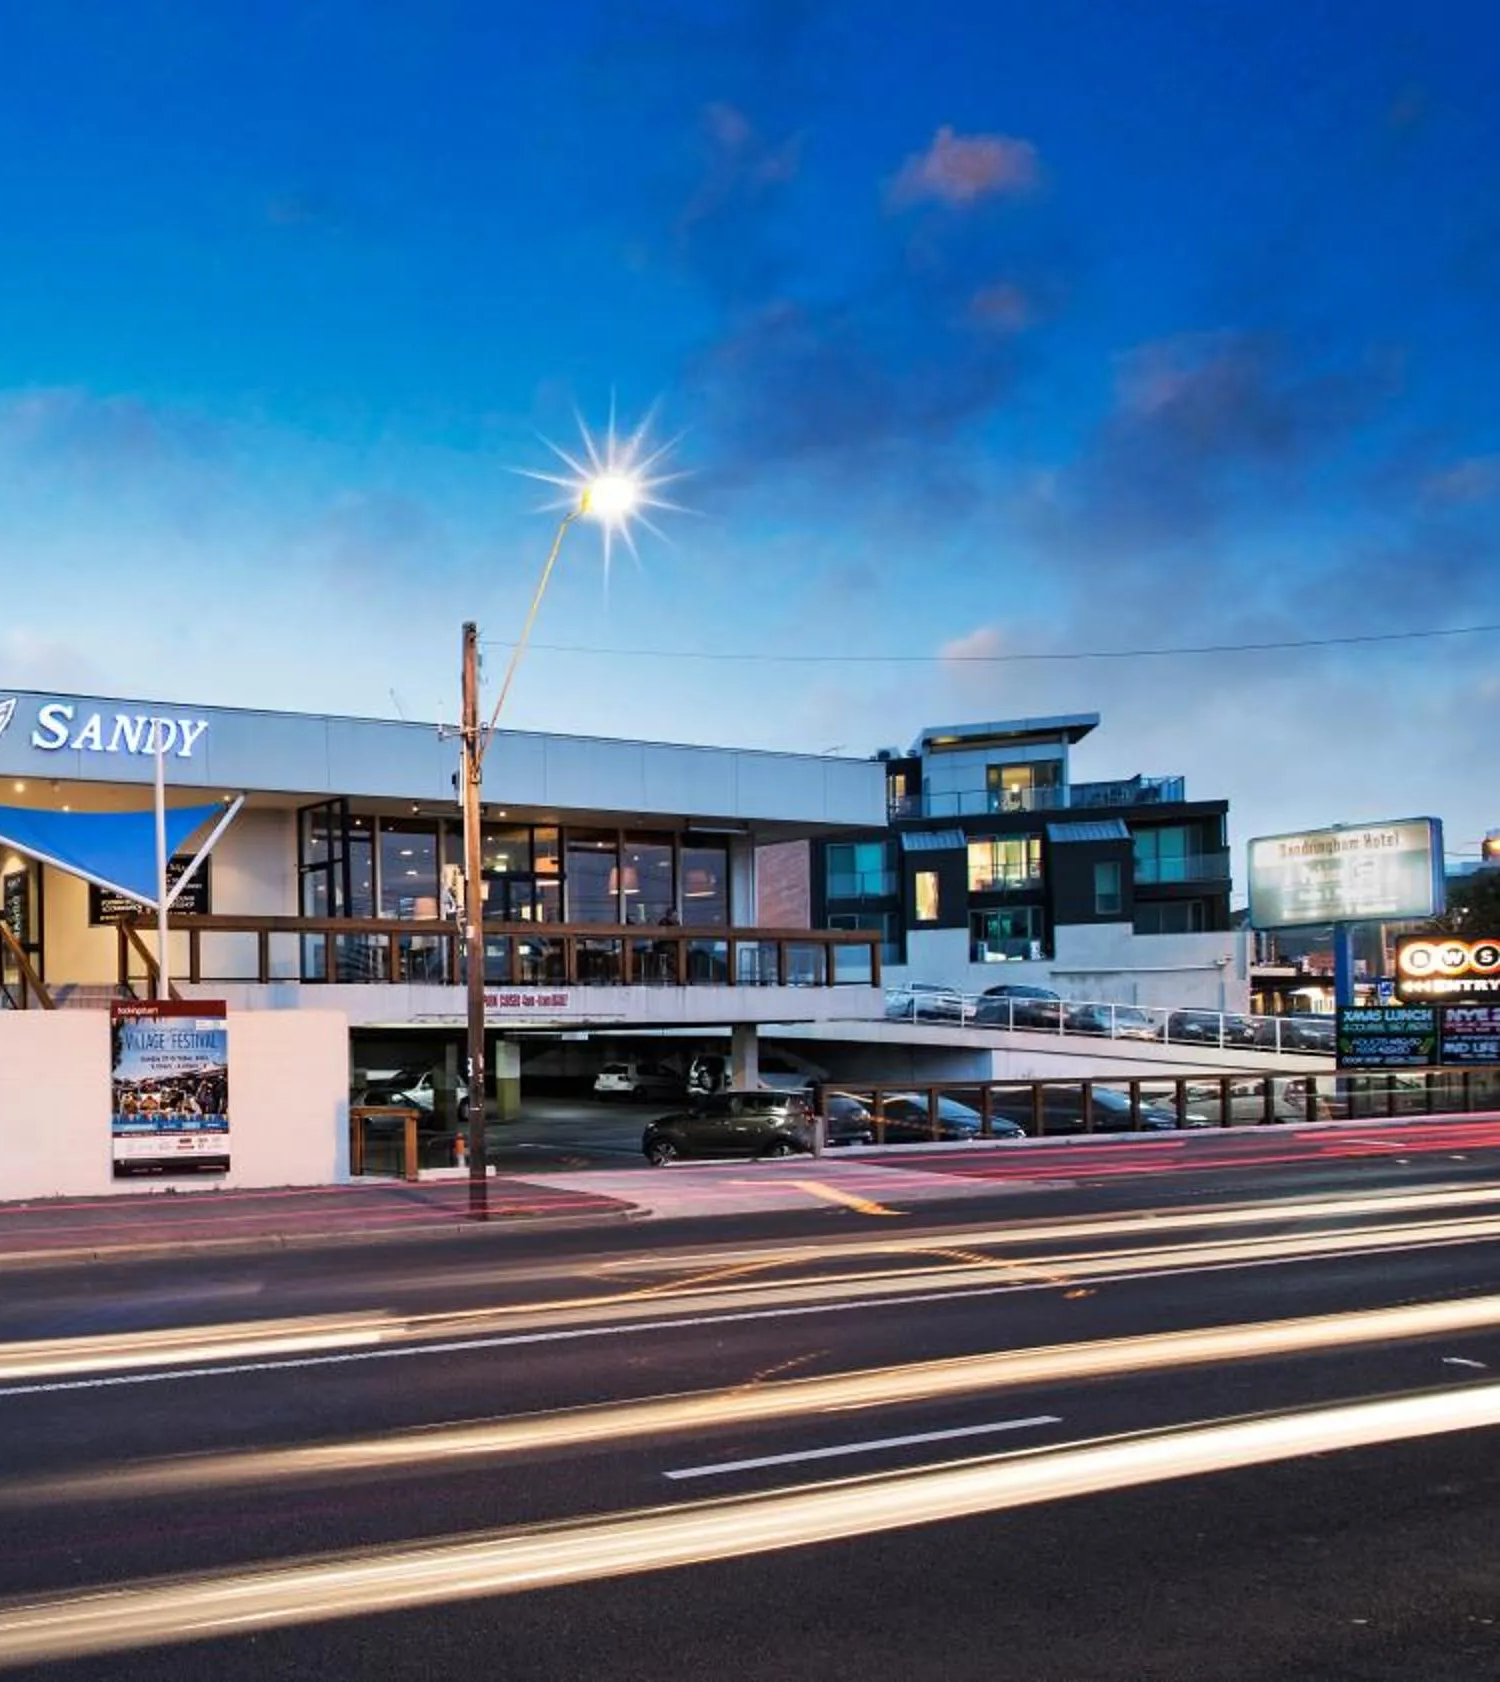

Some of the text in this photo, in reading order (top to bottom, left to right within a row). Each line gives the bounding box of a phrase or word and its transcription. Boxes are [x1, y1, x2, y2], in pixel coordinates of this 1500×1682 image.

[32, 703, 208, 758] SANDY
[1363, 830, 1400, 849] Hotel
[1384, 1009, 1433, 1022] LUNCH
[171, 1031, 218, 1050] FESTIVAL
